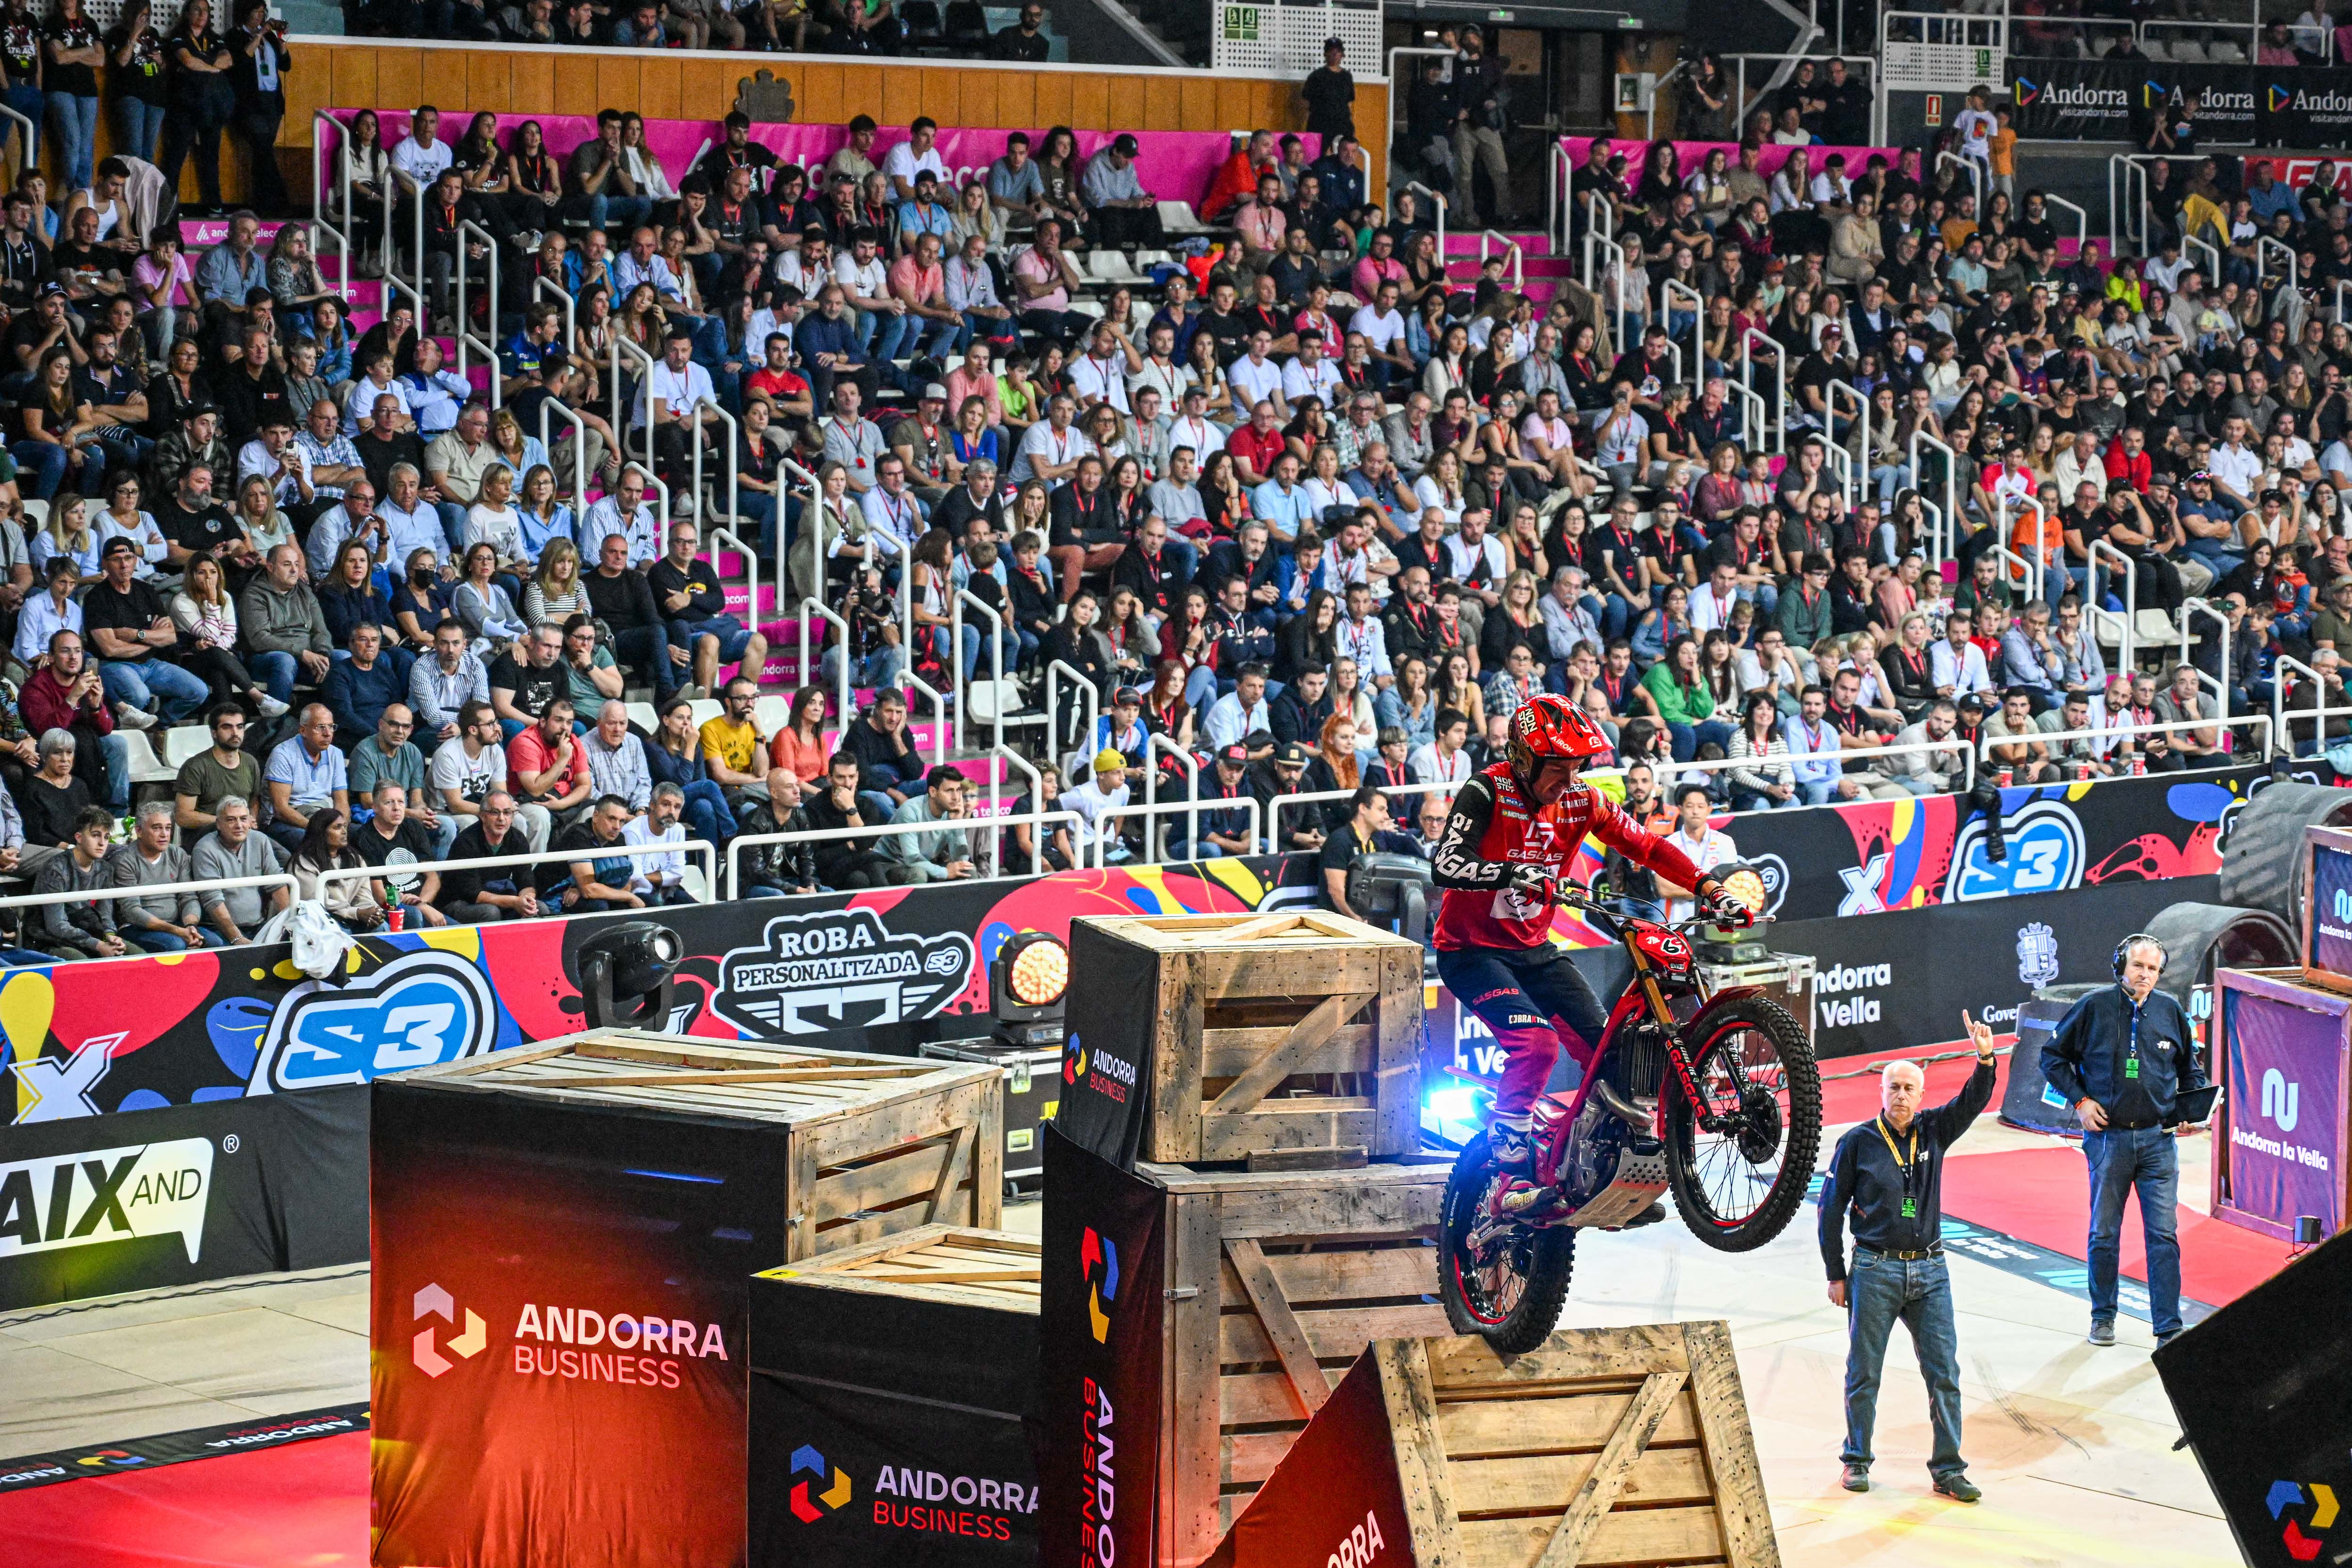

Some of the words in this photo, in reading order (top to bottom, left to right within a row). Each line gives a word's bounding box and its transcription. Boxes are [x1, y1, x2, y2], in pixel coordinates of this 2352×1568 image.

[2041, 82, 2129, 106] Andorra
[2169, 85, 2254, 108] Adorra
[2060, 108, 2129, 118] visitandorra.com
[2194, 111, 2255, 121] sitandorra.com
[762, 663, 795, 675] ndorra
[1525, 707, 1538, 732] NON
[1551, 736, 1574, 753] AIROH
[1507, 848, 1564, 863] GASGAS
[779, 924, 876, 959] ROBA
[2319, 923, 2345, 939] Andorra
[736, 951, 919, 987] PERSONALITZADA
[925, 947, 961, 974] S3
[1814, 963, 1891, 994] ndorra
[1472, 987, 1519, 1006] GASGAS
[1820, 996, 1881, 1028] Vella
[1983, 1005, 2019, 1023] Gove
[277, 984, 474, 1090] S3
[1092, 1048, 1135, 1086] ANDORRA
[1089, 1072, 1126, 1103] BUSINESS
[1670, 1049, 1707, 1117] GASGAS
[2231, 1126, 2281, 1157] Andorra
[2283, 1141, 2295, 1161] la
[2297, 1145, 2328, 1171] Vella
[515, 1304, 729, 1361] ANDORRA
[514, 1345, 681, 1388] BUSINESS
[206, 1418, 354, 1449] ANDORRA
[0, 1467, 66, 1484] AND
[875, 1465, 1038, 1513] ANDORRA
[1098, 1385, 1114, 1568] ANDO
[873, 1500, 1010, 1541] BUSINESS
